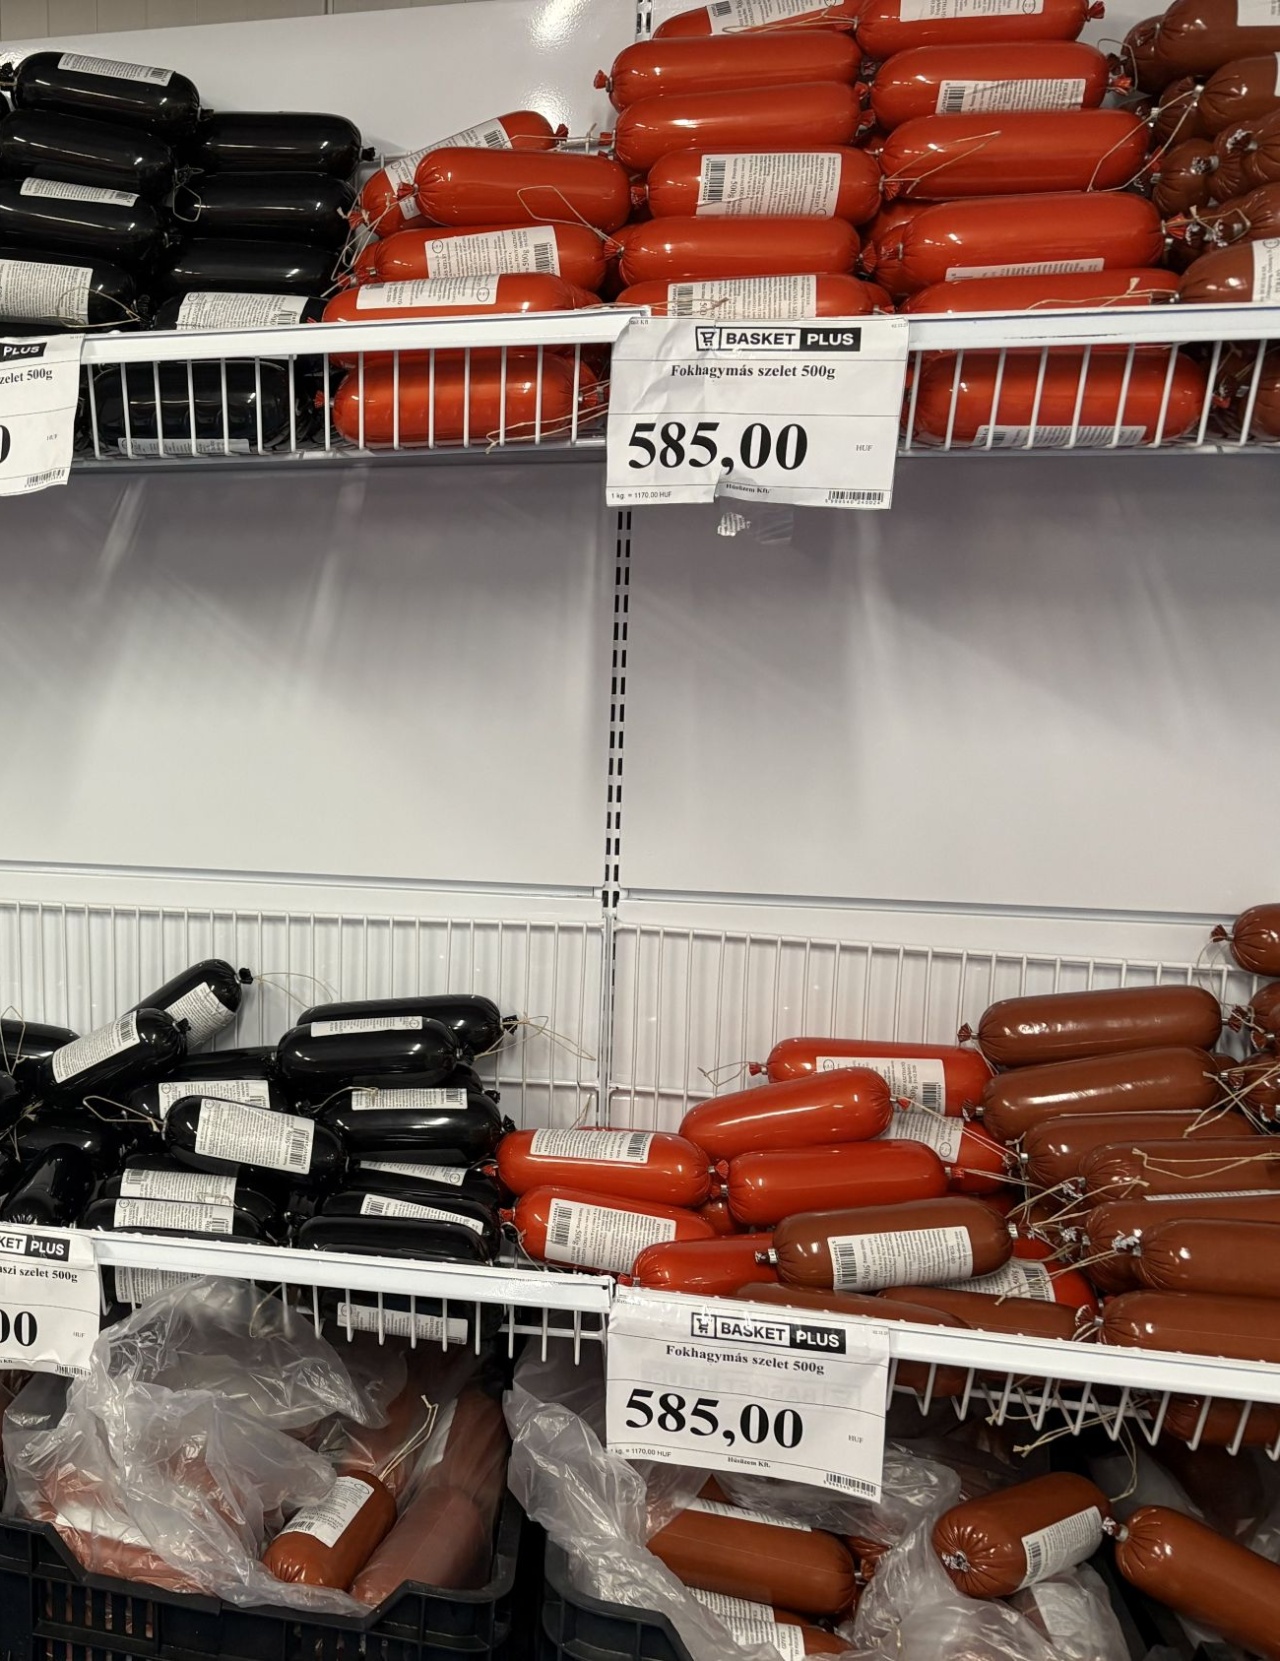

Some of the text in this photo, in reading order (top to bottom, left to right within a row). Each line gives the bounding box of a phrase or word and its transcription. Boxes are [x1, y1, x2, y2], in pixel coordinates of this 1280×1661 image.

[727, 181, 738, 199] 500g
[522, 249, 530, 267] 500g
[726, 333, 854, 345] BASKET PLUS
[2, 346, 40, 357] PLUS
[26, 368, 53, 381] 500g
[671, 364, 835, 380] Fokhagymás szelet 500g
[628, 421, 808, 475] 585,00
[30, 1240, 64, 1256] PLUS
[19, 1266, 48, 1278] szelet
[52, 1269, 78, 1283] 500g
[863, 1264, 872, 1280] 500g
[721, 1322, 840, 1348] BASKET PLUS
[666, 1345, 825, 1375] Fokhagymás szelet 500g
[625, 1388, 803, 1449] 585,00
[848, 1434, 864, 1443] HUF
[632, 1448, 655, 1456] 1170,00
